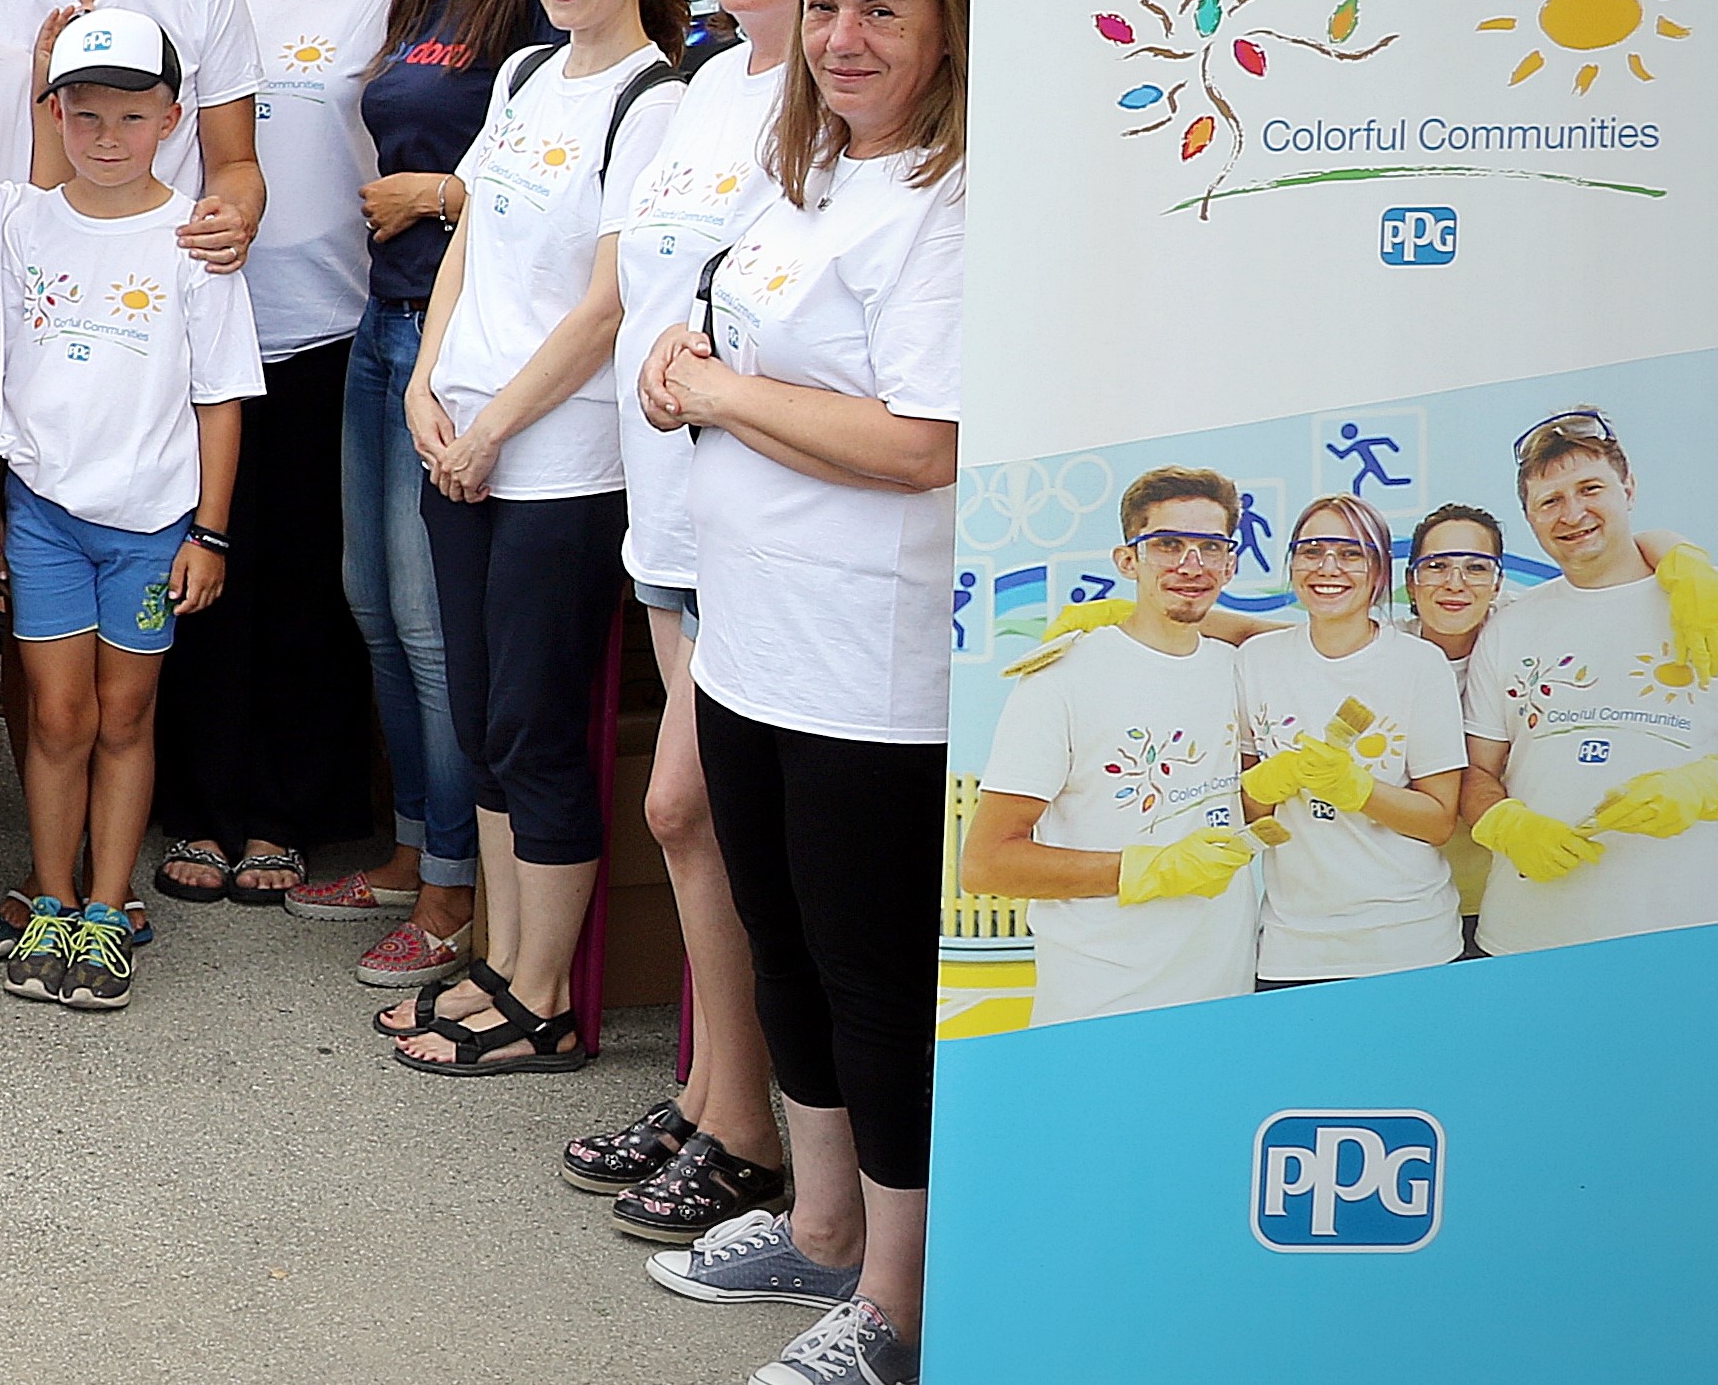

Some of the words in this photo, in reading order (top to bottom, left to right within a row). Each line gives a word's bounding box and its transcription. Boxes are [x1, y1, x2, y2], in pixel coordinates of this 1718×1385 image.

[84, 31, 112, 52] PPG
[266, 80, 325, 91] ommunities
[1262, 117, 1406, 153] Colorful
[1416, 115, 1661, 152] Communities
[1384, 212, 1455, 262] PPG
[83, 320, 150, 342] Communities
[67, 343, 91, 362] PPG
[1598, 707, 1693, 732] Communities
[1580, 742, 1609, 763] PPG
[1311, 801, 1336, 820] PPG
[1265, 1126, 1431, 1236] PPG
